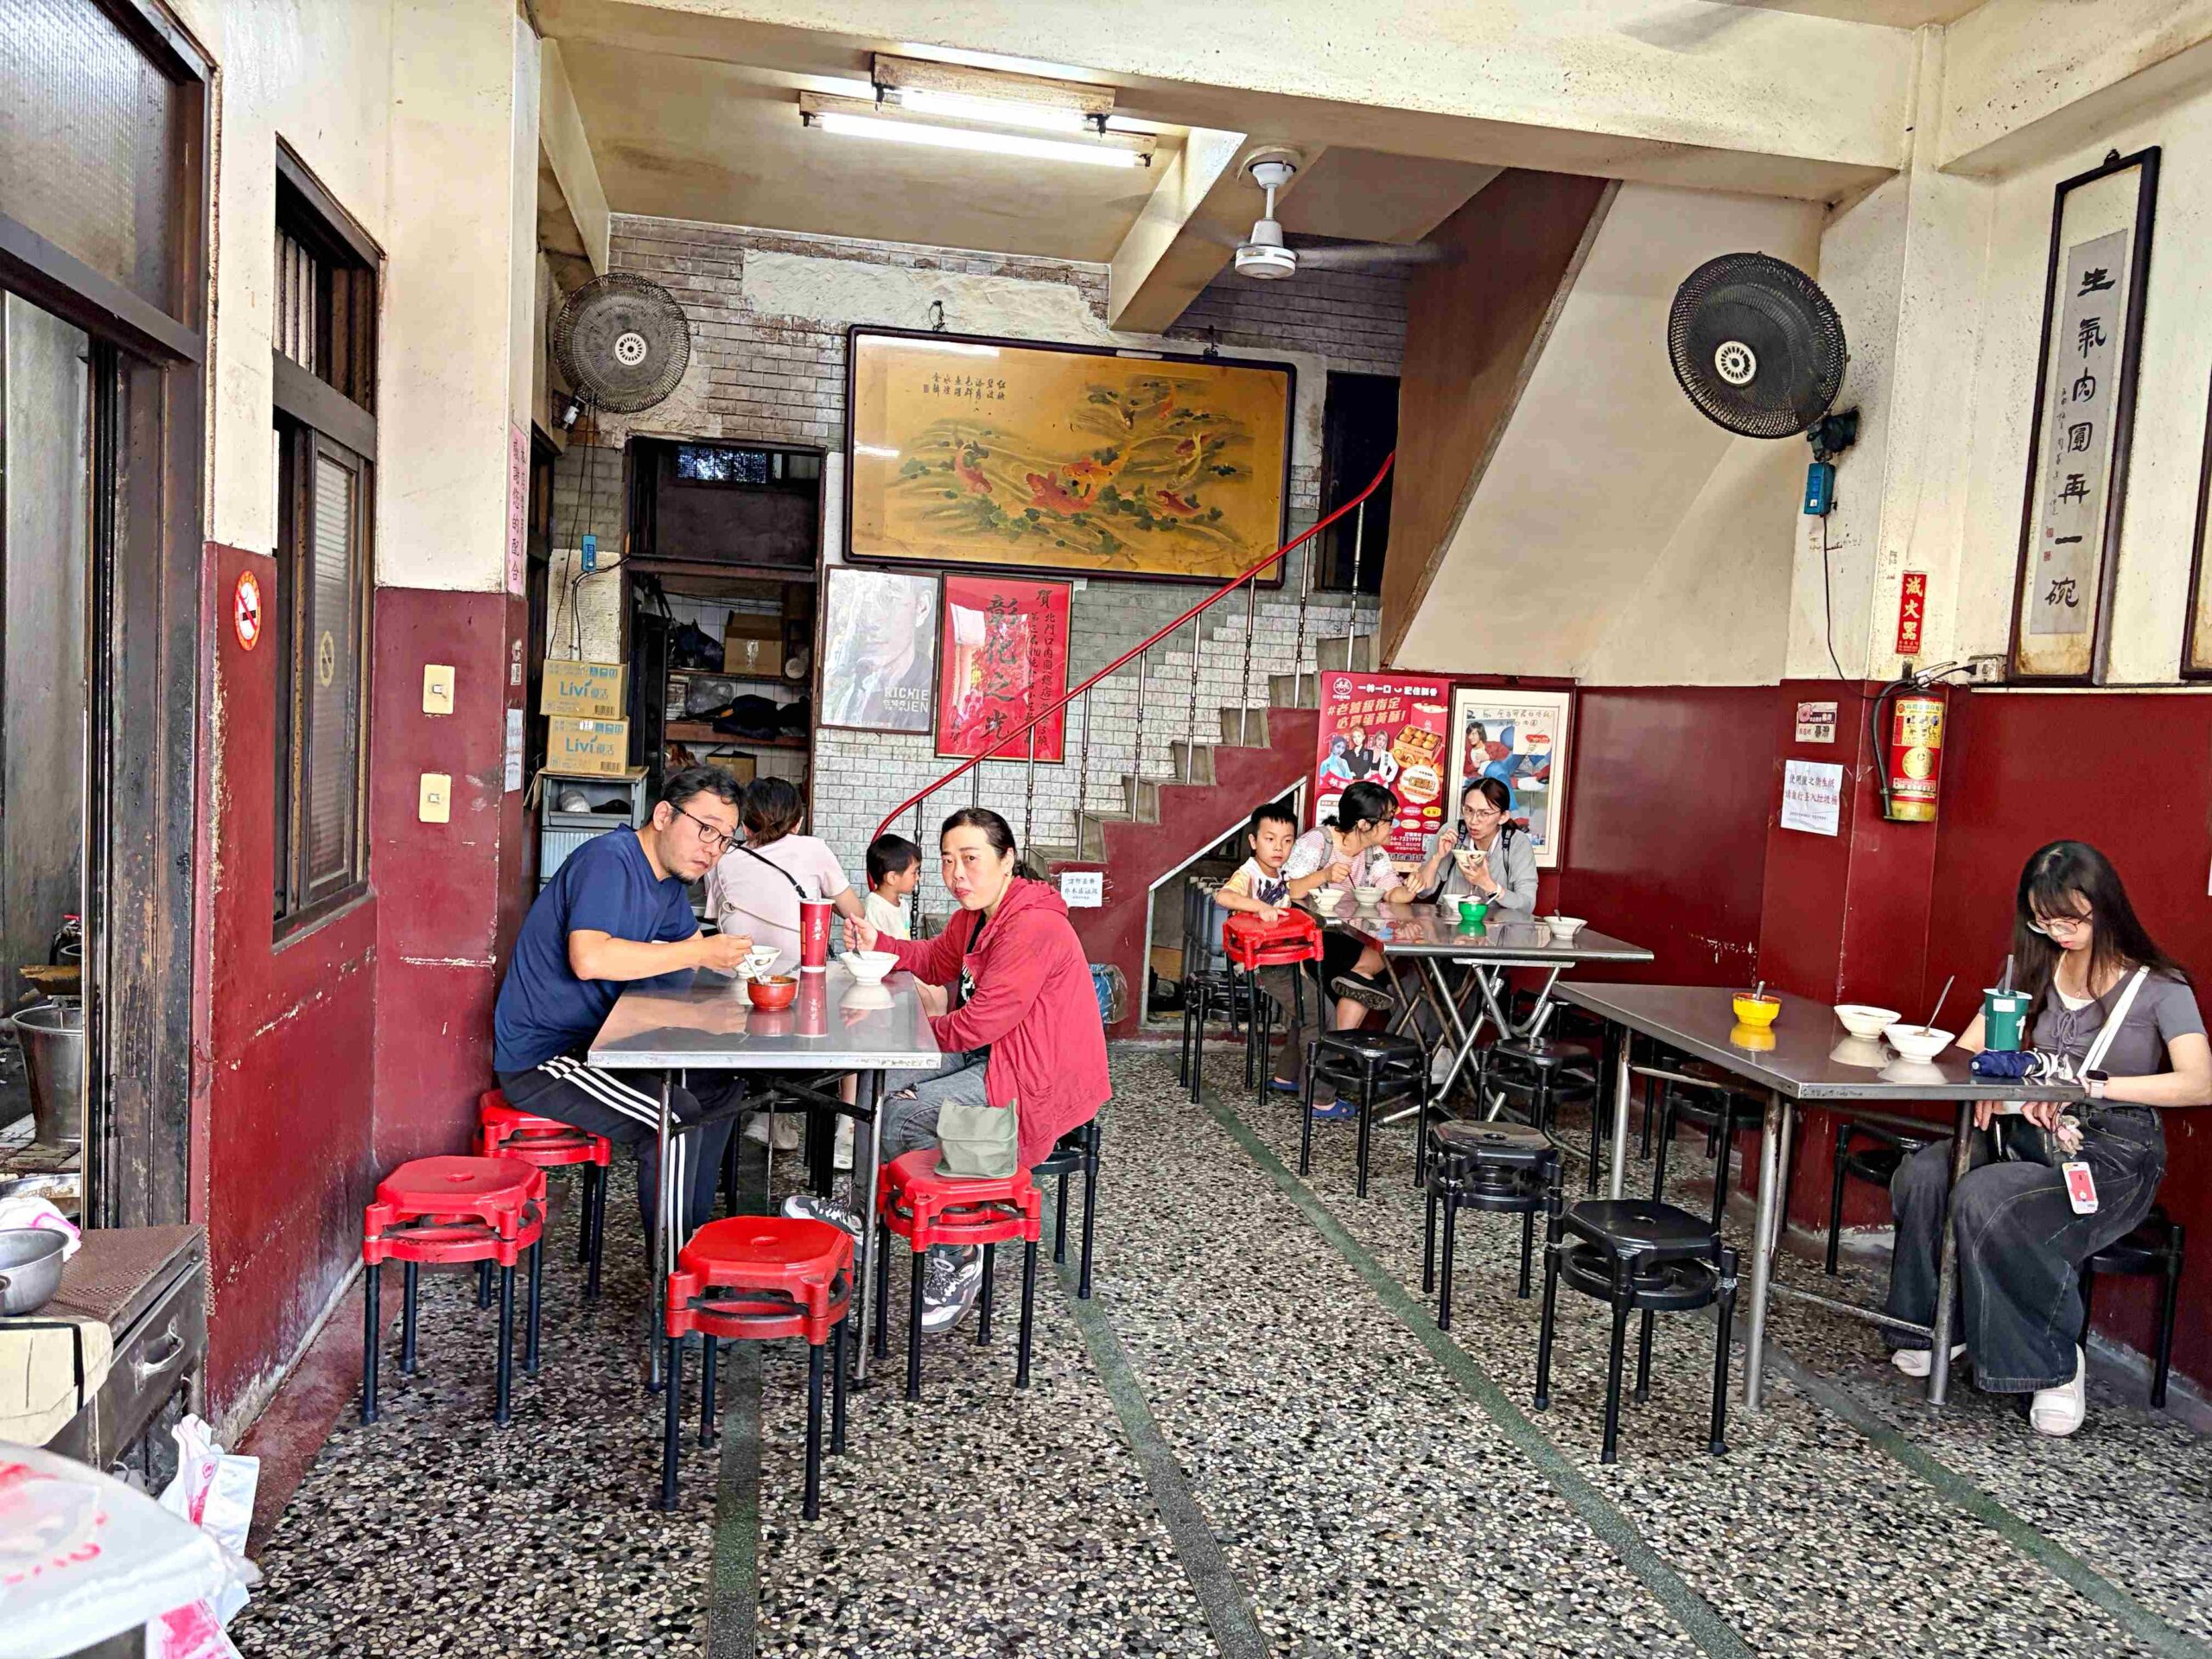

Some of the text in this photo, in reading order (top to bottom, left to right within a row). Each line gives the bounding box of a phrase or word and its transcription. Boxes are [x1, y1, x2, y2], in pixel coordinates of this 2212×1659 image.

[1036, 589, 1053, 609] 賀
[1903, 575, 1923, 640] 滅火器
[560, 679, 593, 697] Livi
[884, 686, 929, 701] RICHIE
[904, 701, 929, 713] JEN
[566, 735, 598, 754] Livi
